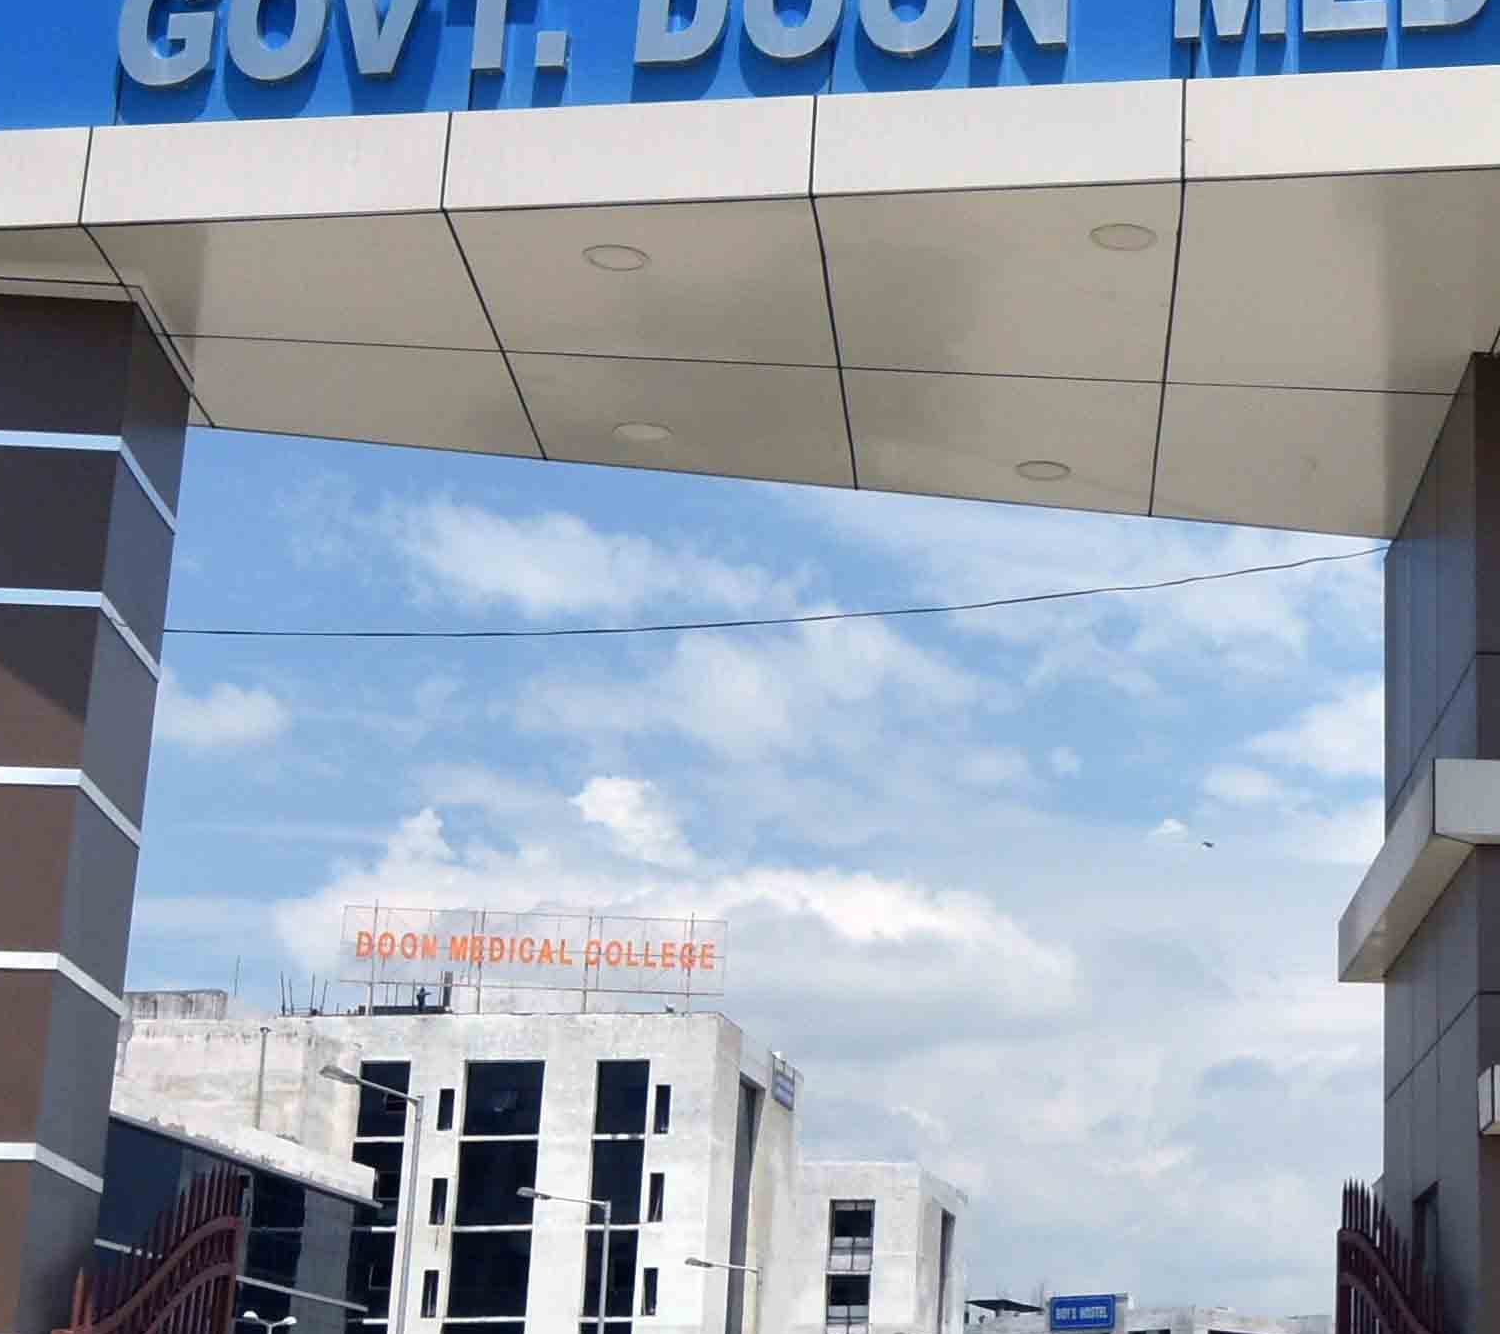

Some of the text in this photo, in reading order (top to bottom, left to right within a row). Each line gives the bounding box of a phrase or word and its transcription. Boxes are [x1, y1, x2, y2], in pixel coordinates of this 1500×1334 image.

[355, 930, 716, 970] DOON MEDICAL COLLEGE
